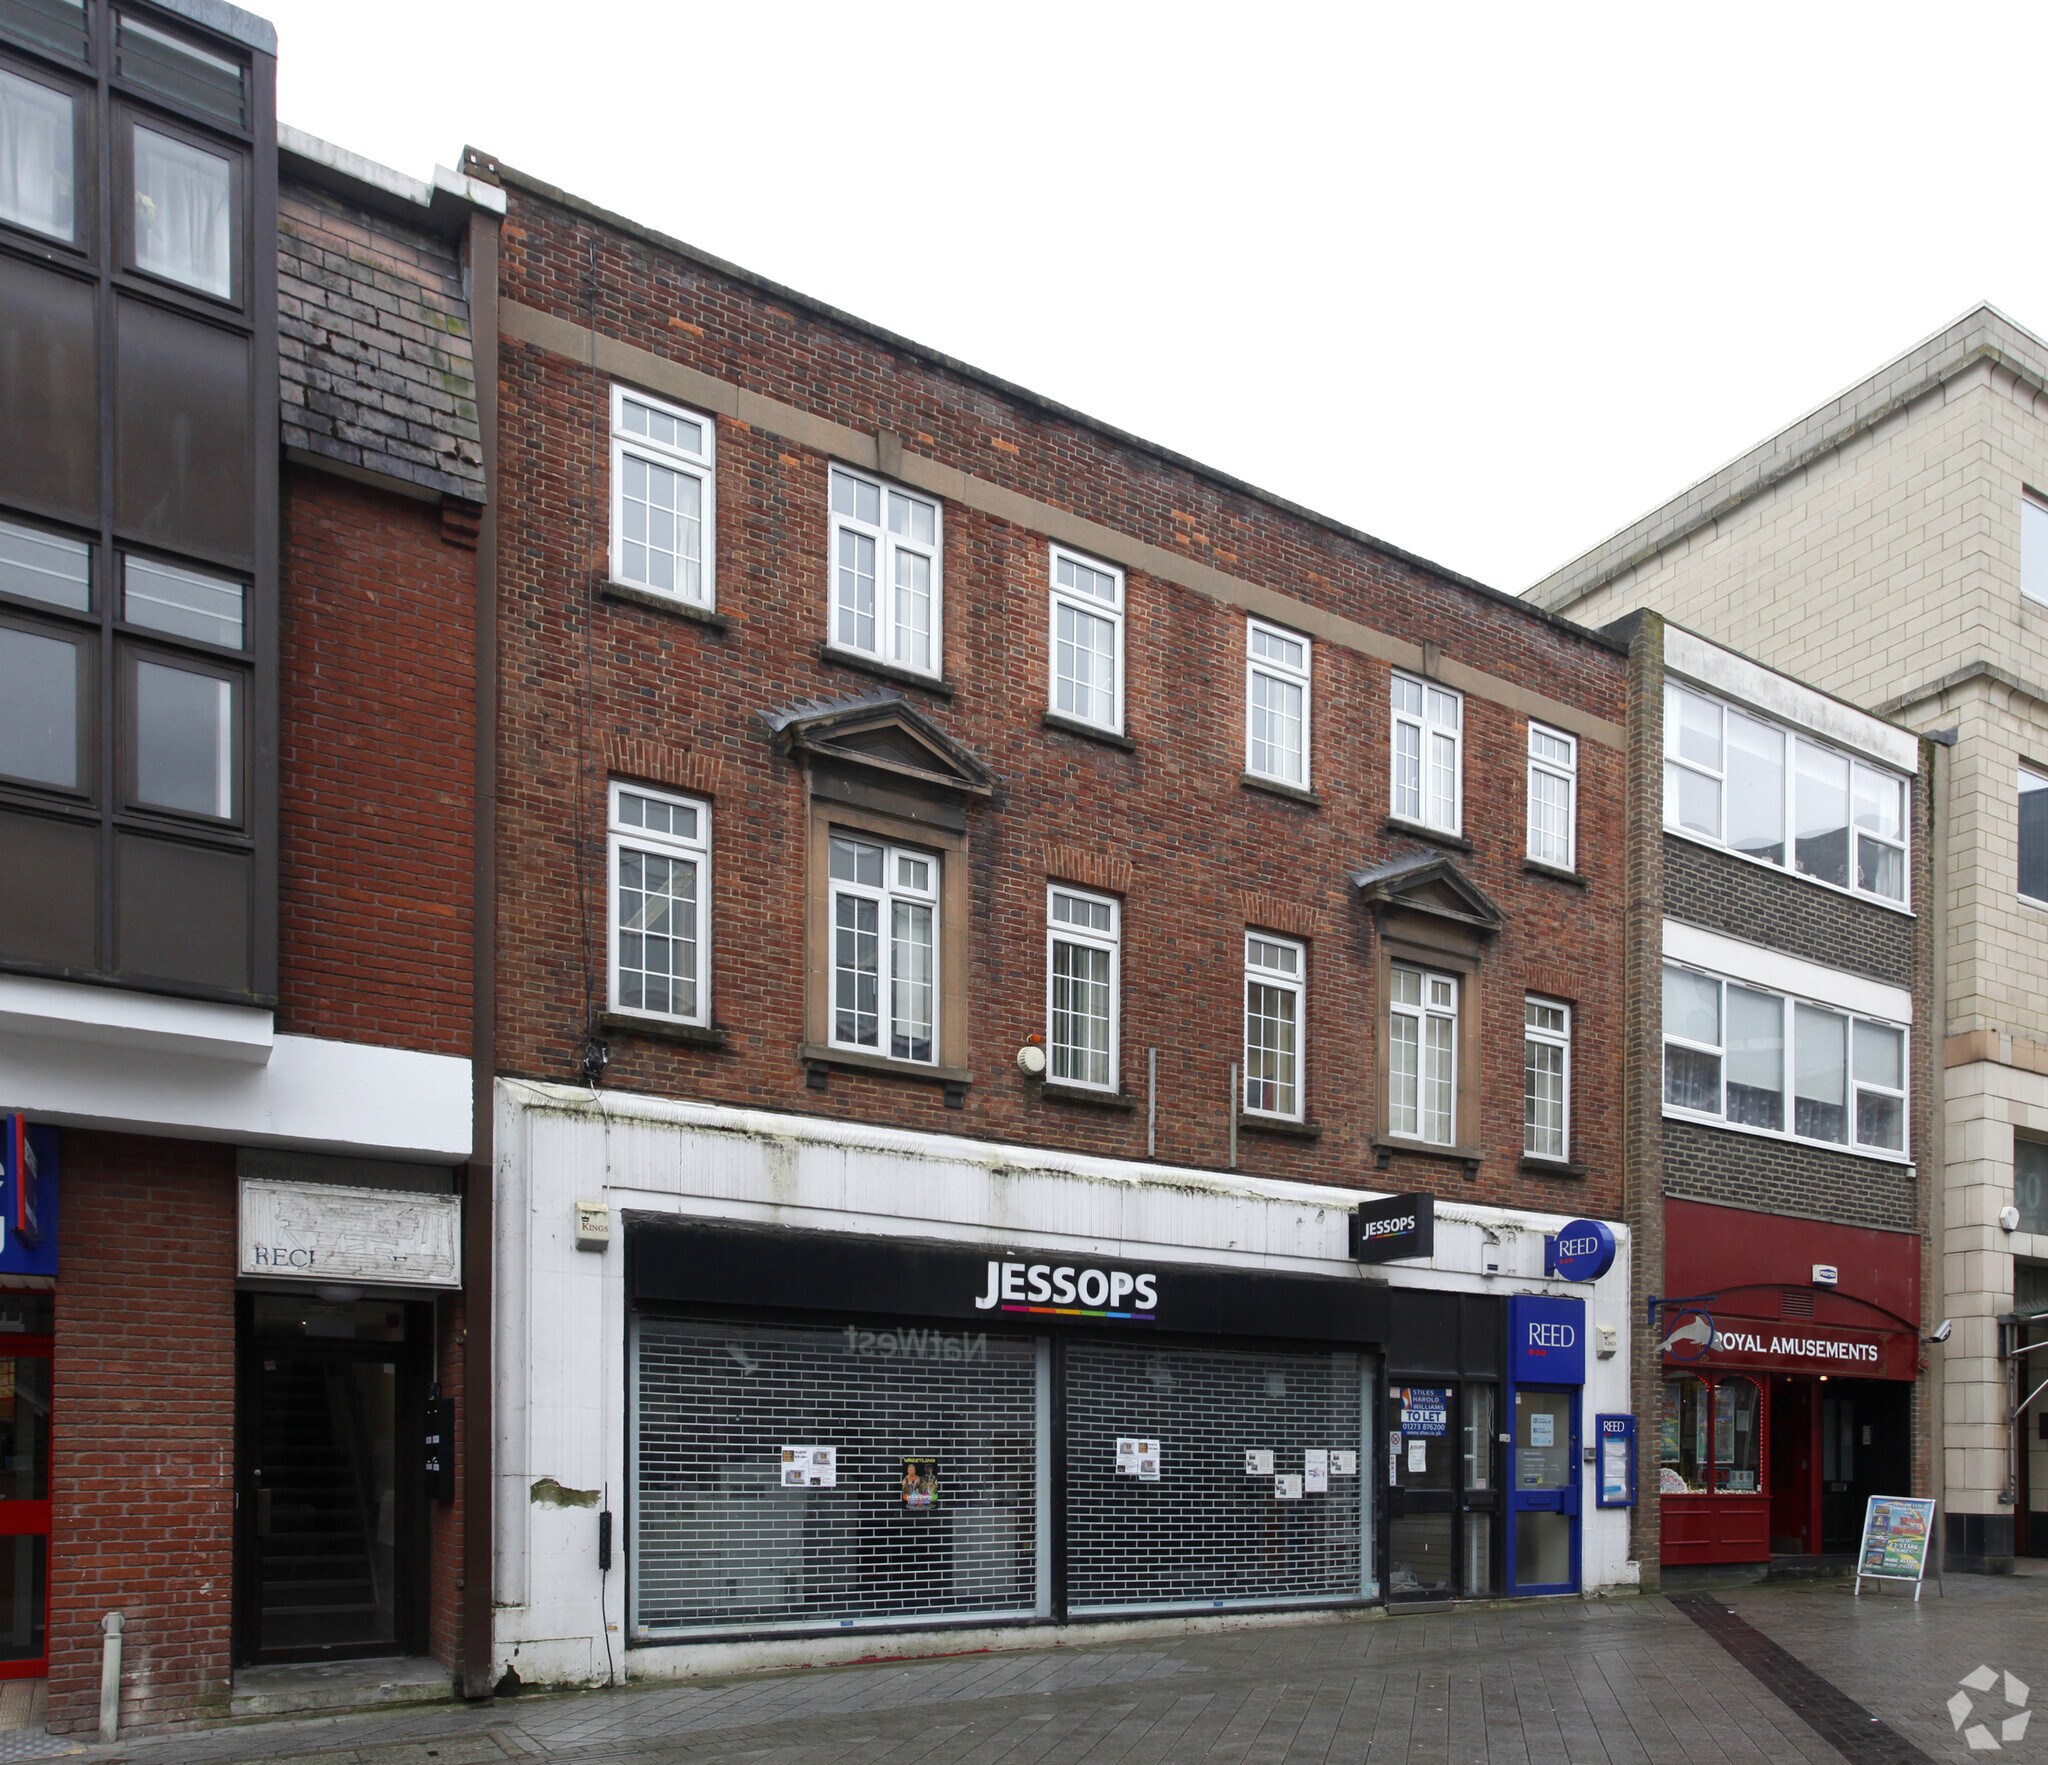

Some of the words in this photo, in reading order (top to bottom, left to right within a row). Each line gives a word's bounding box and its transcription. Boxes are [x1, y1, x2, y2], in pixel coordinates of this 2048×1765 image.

[1362, 1215, 1416, 1241] JESSOPS
[1559, 1236, 1598, 1257] REED
[975, 1260, 1158, 1310] JESSOPS
[1529, 1322, 1575, 1348] REED
[1769, 1336, 1879, 1362] AMUSEMENTS
[1406, 1411, 1421, 1422] TO
[1422, 1411, 1442, 1422] LET
[1422, 1423, 1446, 1431] 876200
[1603, 1420, 1625, 1432] REED
